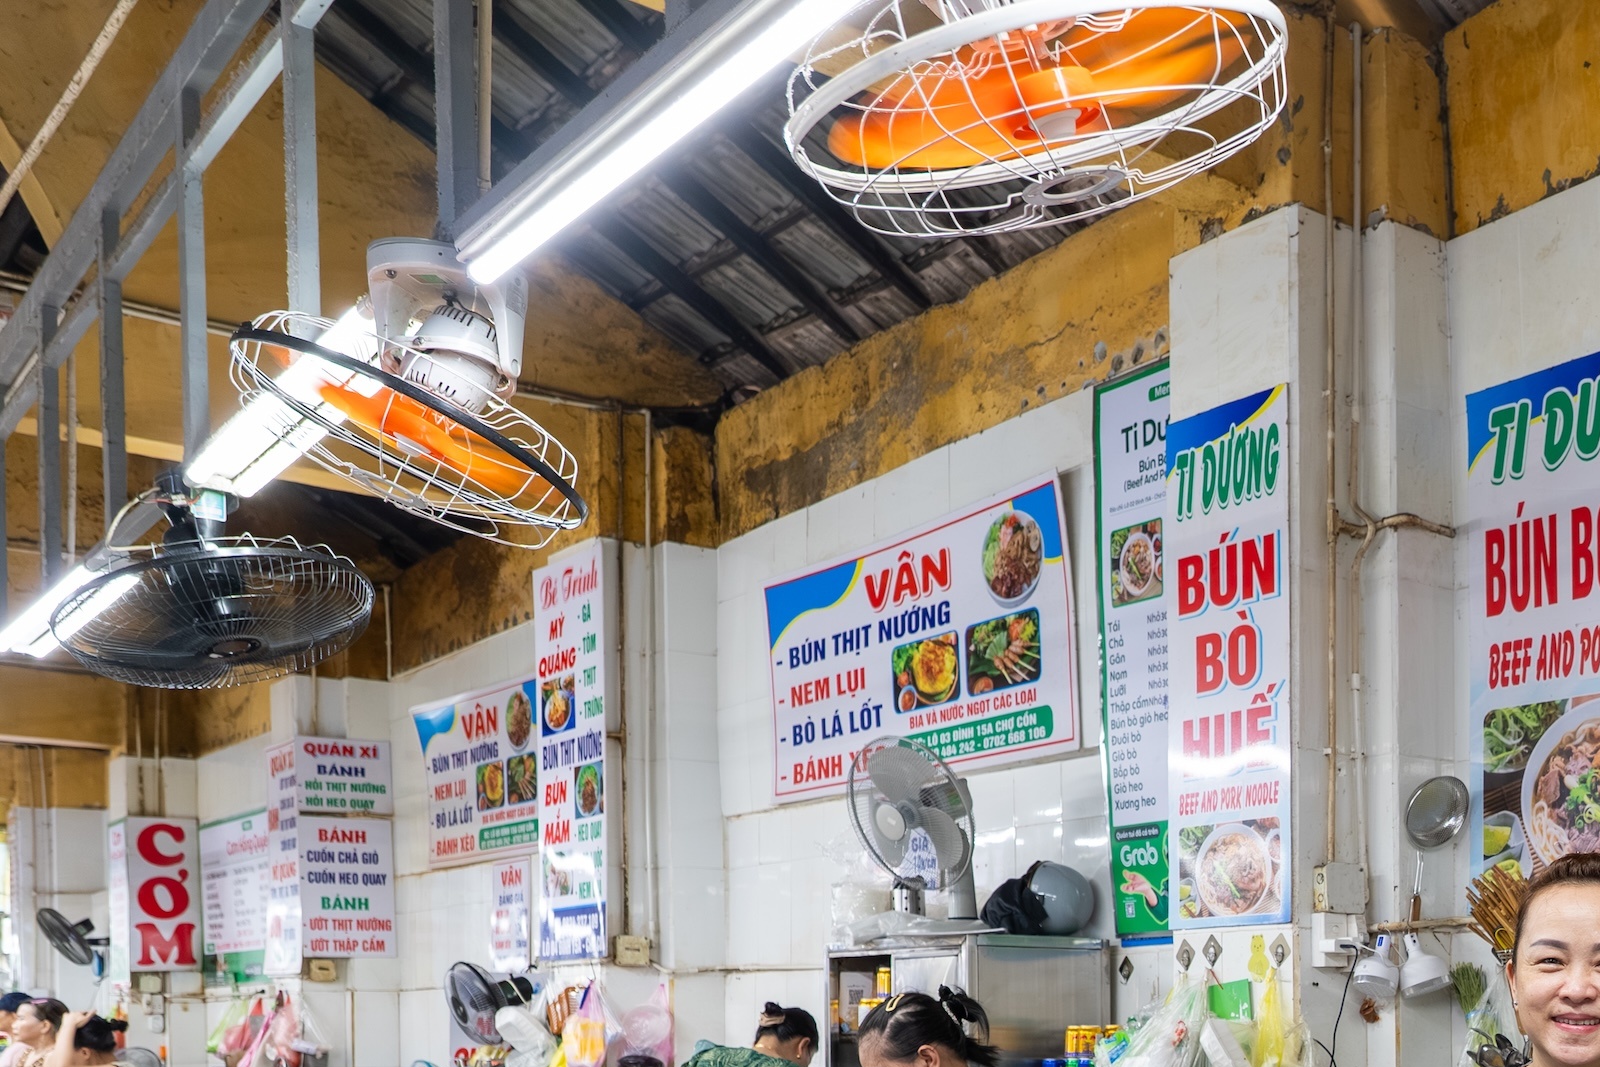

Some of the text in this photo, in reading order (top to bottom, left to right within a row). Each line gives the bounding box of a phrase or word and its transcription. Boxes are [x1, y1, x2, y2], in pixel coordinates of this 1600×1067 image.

[1121, 422, 1138, 454] Ti
[1490, 401, 1531, 484] TI
[1176, 450, 1196, 522] TI
[1201, 422, 1280, 514] DƯƠNG
[1177, 530, 1278, 618] BÚN
[1485, 501, 1558, 618] BÚN
[562, 556, 598, 602] Trinh
[864, 547, 952, 613] VÂN
[582, 599, 591, 622] GÀ
[1108, 620, 1120, 633] Tái
[582, 632, 596, 655] TÔM
[789, 600, 951, 670] BÚN THỊT NƯỚNG
[539, 645, 576, 678] QUẢNG
[1196, 609, 1259, 695] BÒ
[1488, 638, 1533, 690] BEEF
[1536, 630, 1575, 681] AND
[790, 667, 866, 708] NEM LỤI
[461, 702, 499, 743] VÂN
[792, 697, 884, 747] BÒ LÁ LỐT
[909, 715, 924, 729] BIA
[926, 709, 938, 726] VÀ
[967, 699, 990, 717] NGỌT
[993, 692, 1013, 711] CÁC
[1015, 688, 1037, 707] LOẠI
[976, 722, 994, 737] 15A
[995, 715, 1015, 734] CHỢ
[303, 741, 379, 759] QUÁN XÍ
[432, 753, 450, 774] BÚN
[451, 750, 468, 771] THỊT
[543, 739, 558, 771] BÚN
[560, 739, 575, 771] THỊT
[317, 762, 366, 778] BÁNH
[794, 751, 843, 786] BÁNH
[326, 782, 347, 794] THỊT
[326, 797, 375, 810] HEO QUAY
[435, 781, 452, 801] NEM
[545, 776, 567, 807] BÚN
[1179, 780, 1280, 816] BEEF AND PORK NOODLE
[318, 826, 367, 844] BÁNH
[544, 808, 570, 846] MẮM
[338, 848, 359, 864] CHẢ
[436, 835, 458, 856] BÁNH
[1120, 841, 1159, 867] Grab
[338, 872, 359, 885] HEO
[362, 873, 387, 887] QUAY
[501, 865, 522, 888] VÂN
[135, 823, 197, 966] CƠM
[321, 893, 369, 911] BÁNH
[332, 919, 353, 934] THỊT
